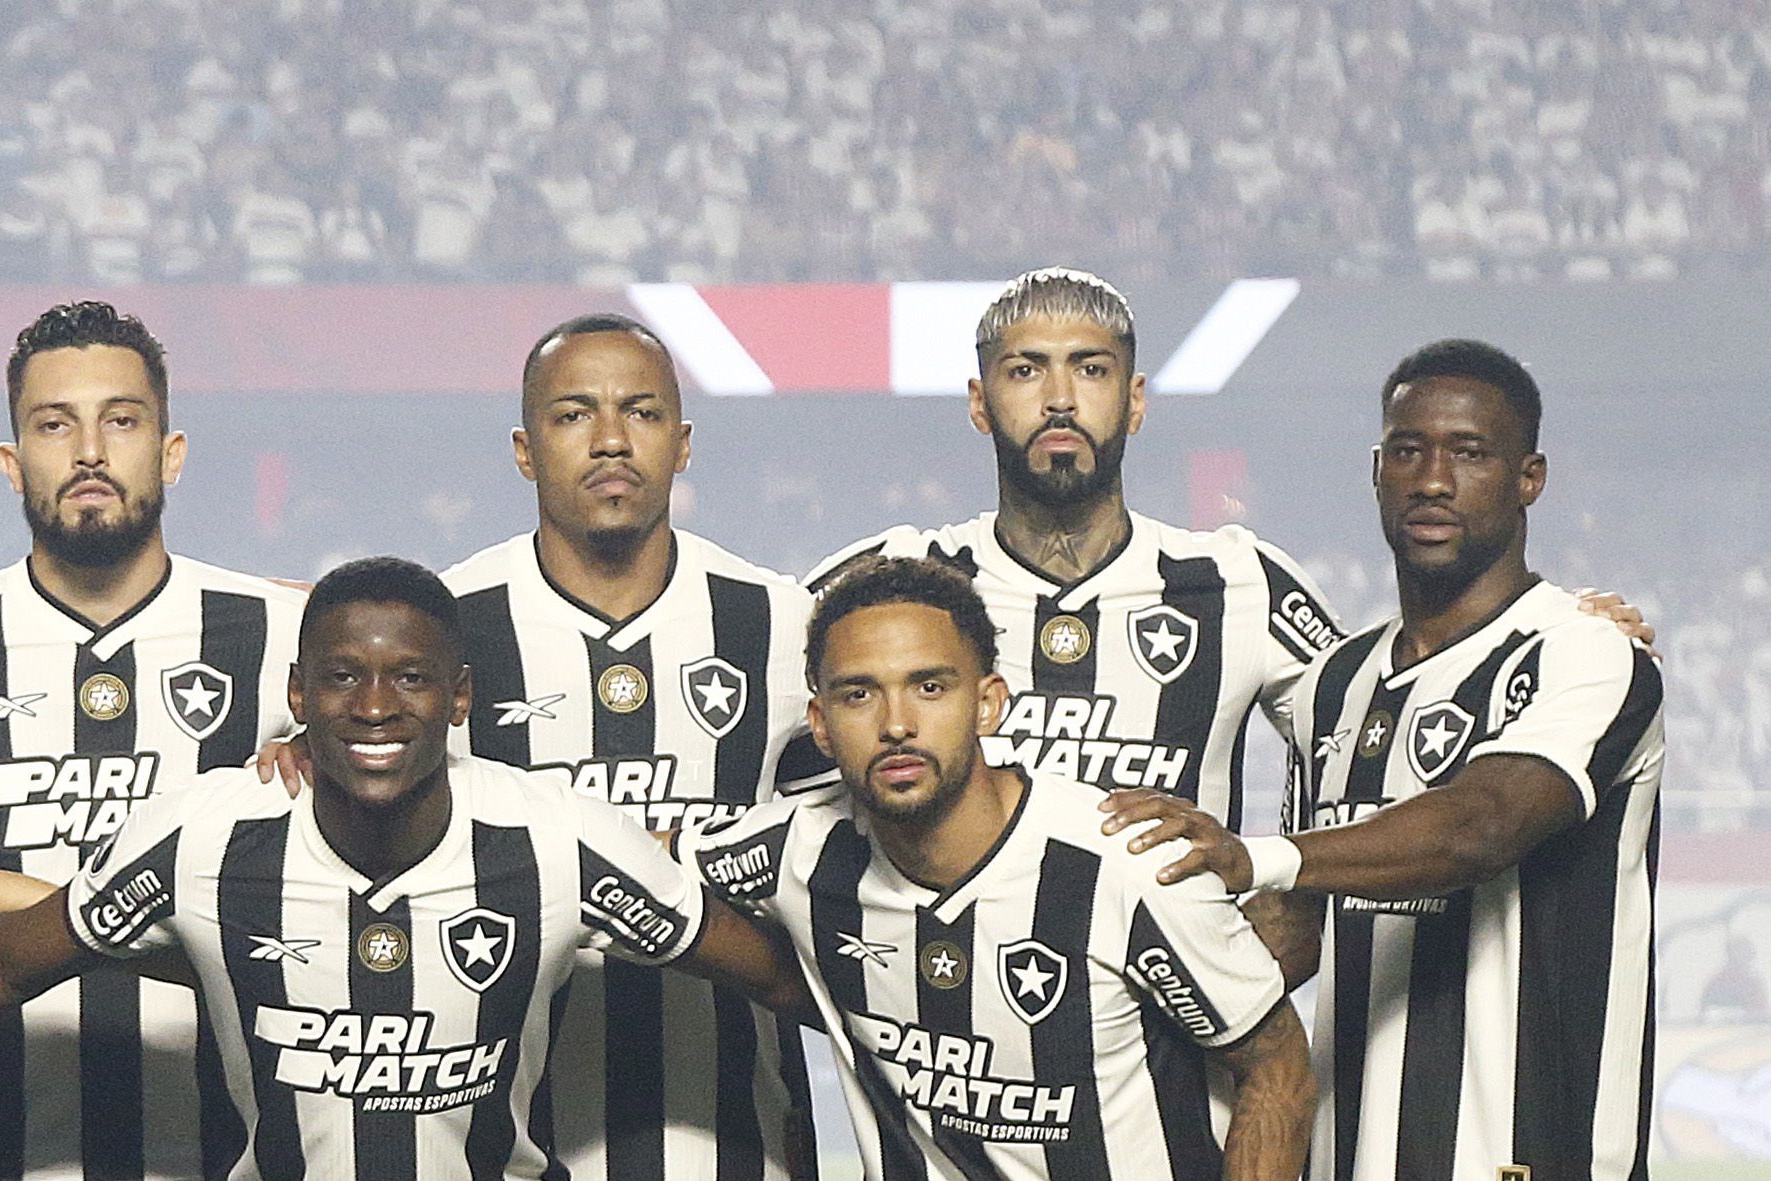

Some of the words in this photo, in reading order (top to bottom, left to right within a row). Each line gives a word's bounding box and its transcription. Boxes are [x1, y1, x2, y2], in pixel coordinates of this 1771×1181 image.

[999, 696, 1111, 741] ARI
[1138, 947, 1216, 1036] Centrum
[255, 1004, 428, 1054] PARI
[852, 1014, 988, 1078] PARI
[275, 1039, 507, 1092] MATCH
[877, 1055, 1076, 1123] MATCH
[363, 1098, 421, 1112] APOSTAS
[941, 1115, 990, 1138] APOSTAS
[991, 1125, 1070, 1141] ESPORTIVAS
